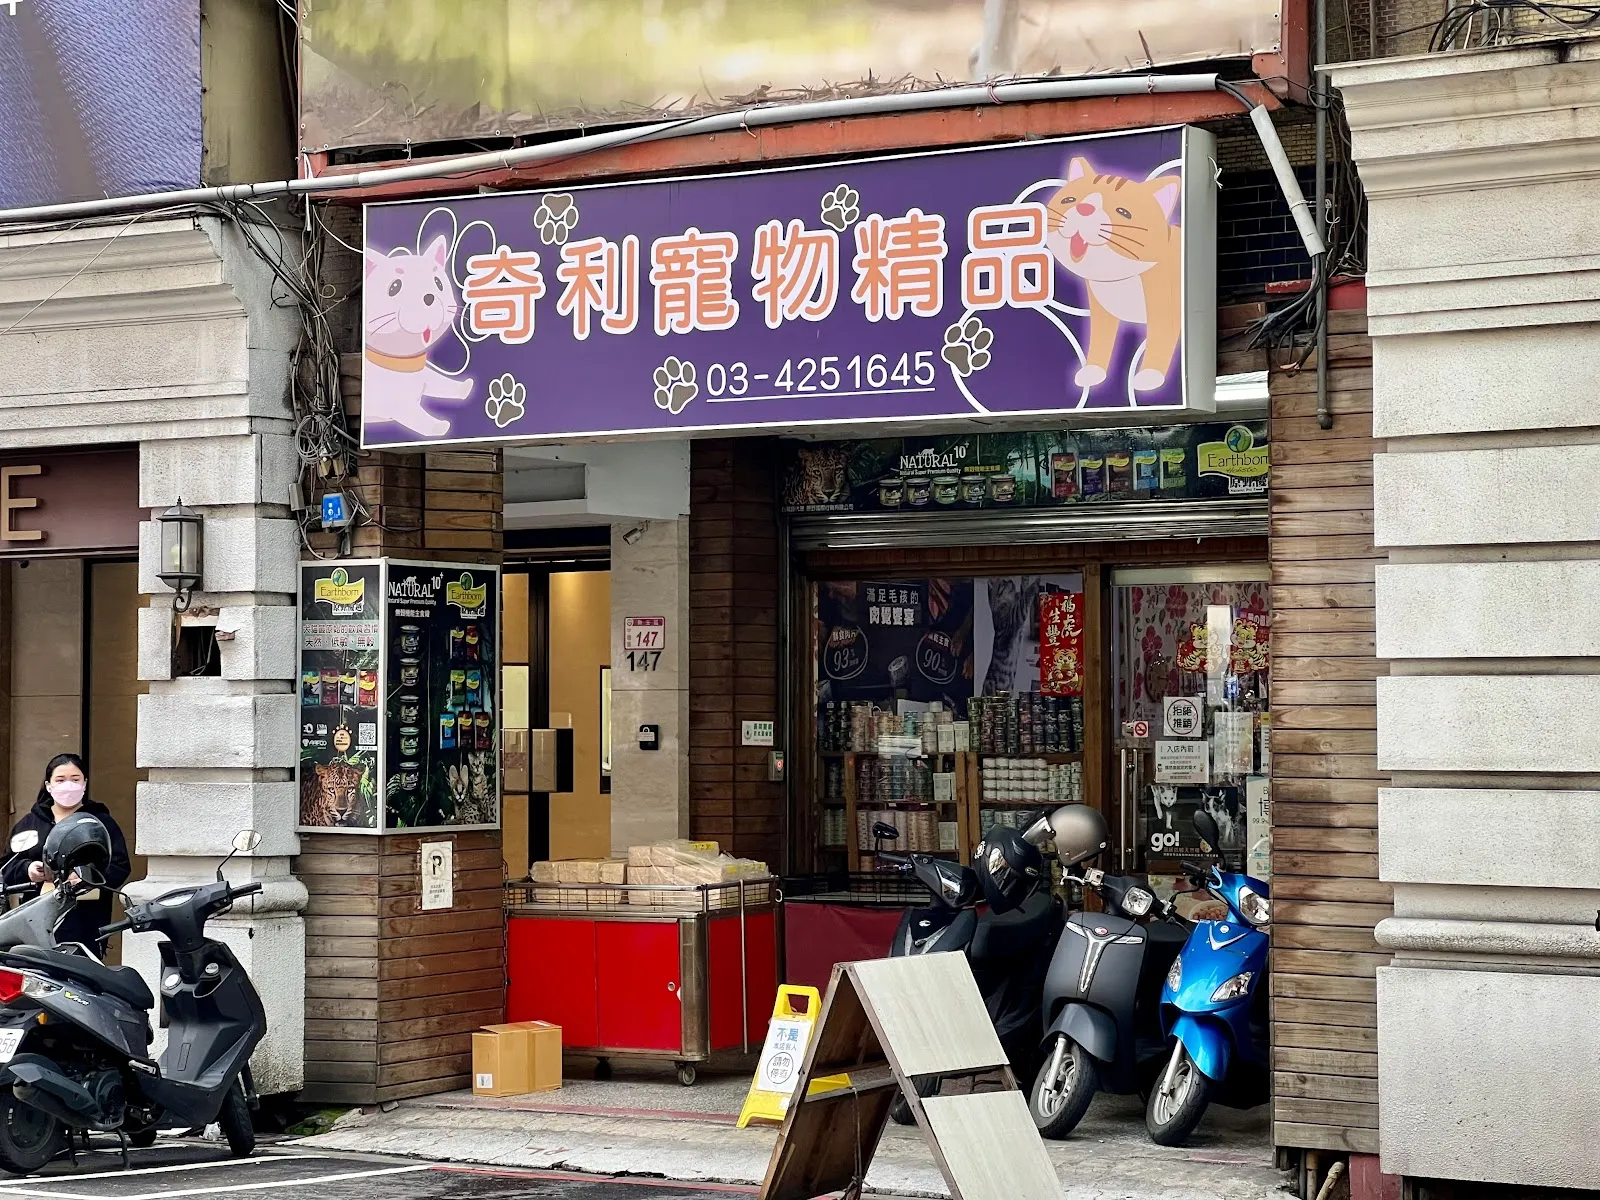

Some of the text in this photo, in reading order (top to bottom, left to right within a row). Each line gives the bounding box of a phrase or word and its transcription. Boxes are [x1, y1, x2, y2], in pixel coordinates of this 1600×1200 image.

[463, 202, 1054, 344] 奇利寵物精品
[706, 351, 935, 396] 03-4251645
[900, 454, 958, 469] NATURAL
[1, 465, 42, 541] E
[320, 586, 359, 597] Earthborn
[388, 582, 434, 598] NATURAL
[636, 631, 659, 647] 147
[627, 651, 661, 671] 147
[1173, 706, 1192, 716] 拒絕
[1173, 719, 1192, 728] 推銷
[1151, 831, 1180, 852] go!
[776, 1027, 799, 1042] 不是
